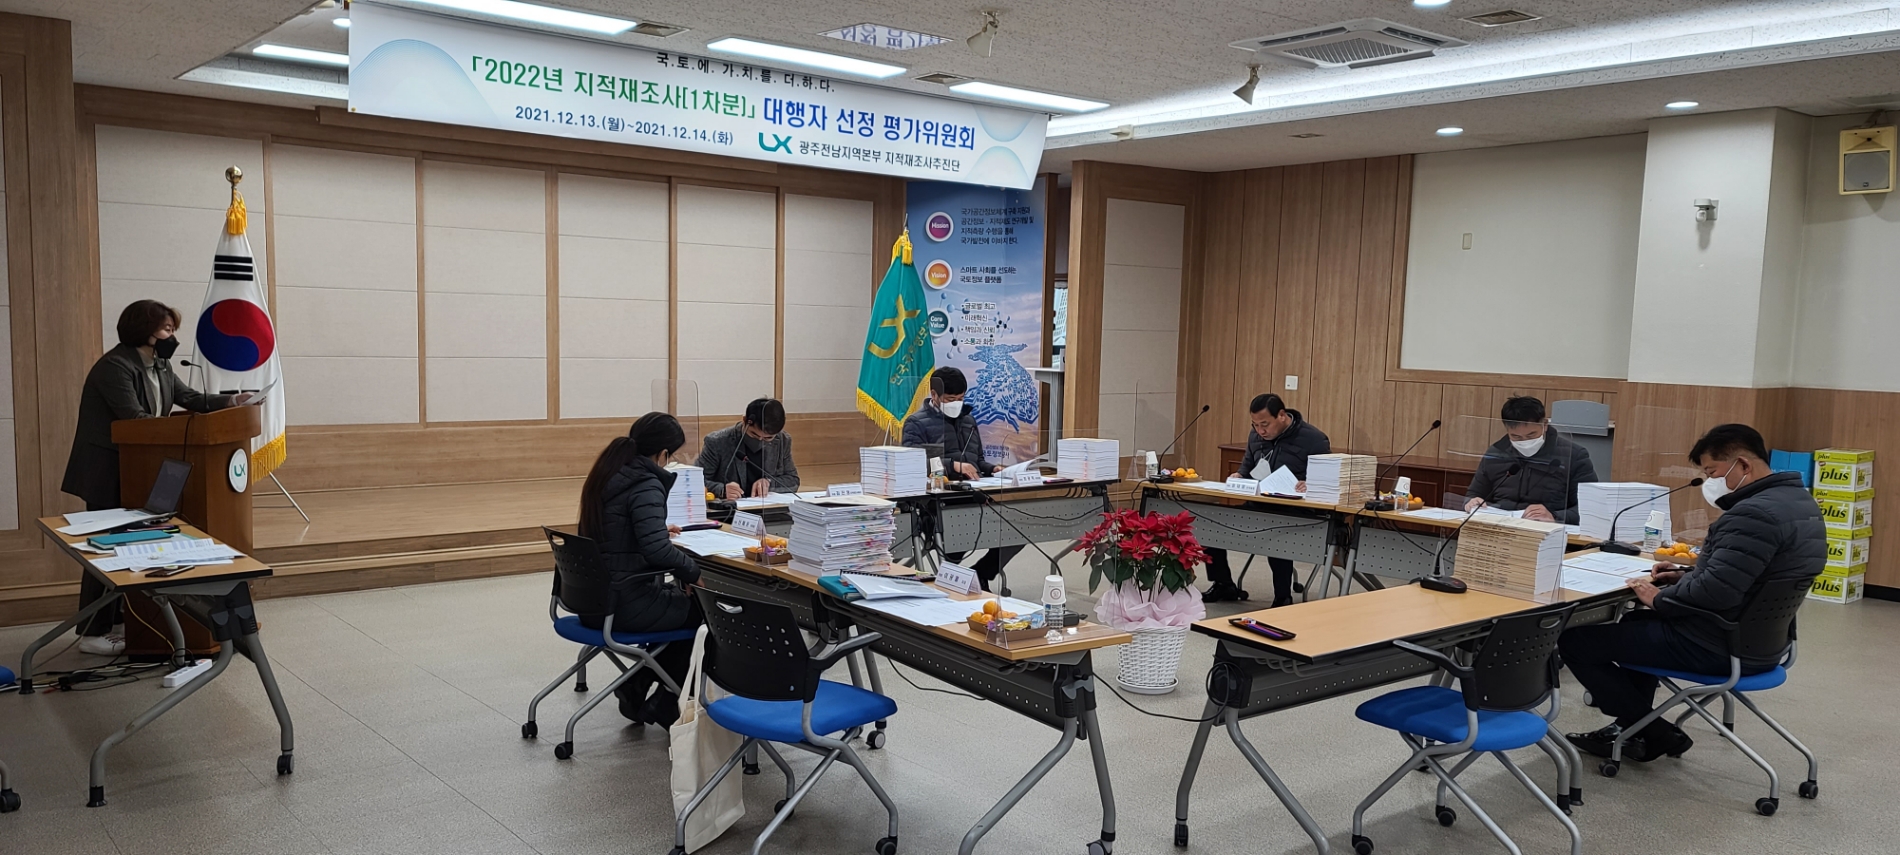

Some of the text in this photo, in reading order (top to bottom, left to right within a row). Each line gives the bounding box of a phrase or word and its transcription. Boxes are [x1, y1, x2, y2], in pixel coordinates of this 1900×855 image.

[656, 52, 835, 92] 국.토.에. 가.치.를. 더.하.다.
[472, 55, 563, 92] 「2022년
[764, 97, 828, 131] 대행자
[836, 108, 875, 138] 선정
[883, 115, 976, 151] 평가위원회
[515, 105, 734, 146] 2021.12.13.(월)~2021.12.14.(화)
[758, 132, 960, 172] LX 광주전남지역본부 지적재조사추진단
[960, 266, 978, 274] 스마트
[979, 266, 997, 274] 사회를
[965, 302, 982, 310] 글로벌
[930, 321, 945, 329] Value
[965, 314, 988, 322] 미래혁신
[233, 463, 246, 477] LX
[1819, 468, 1849, 482] plus
[1811, 579, 1841, 592] plus
